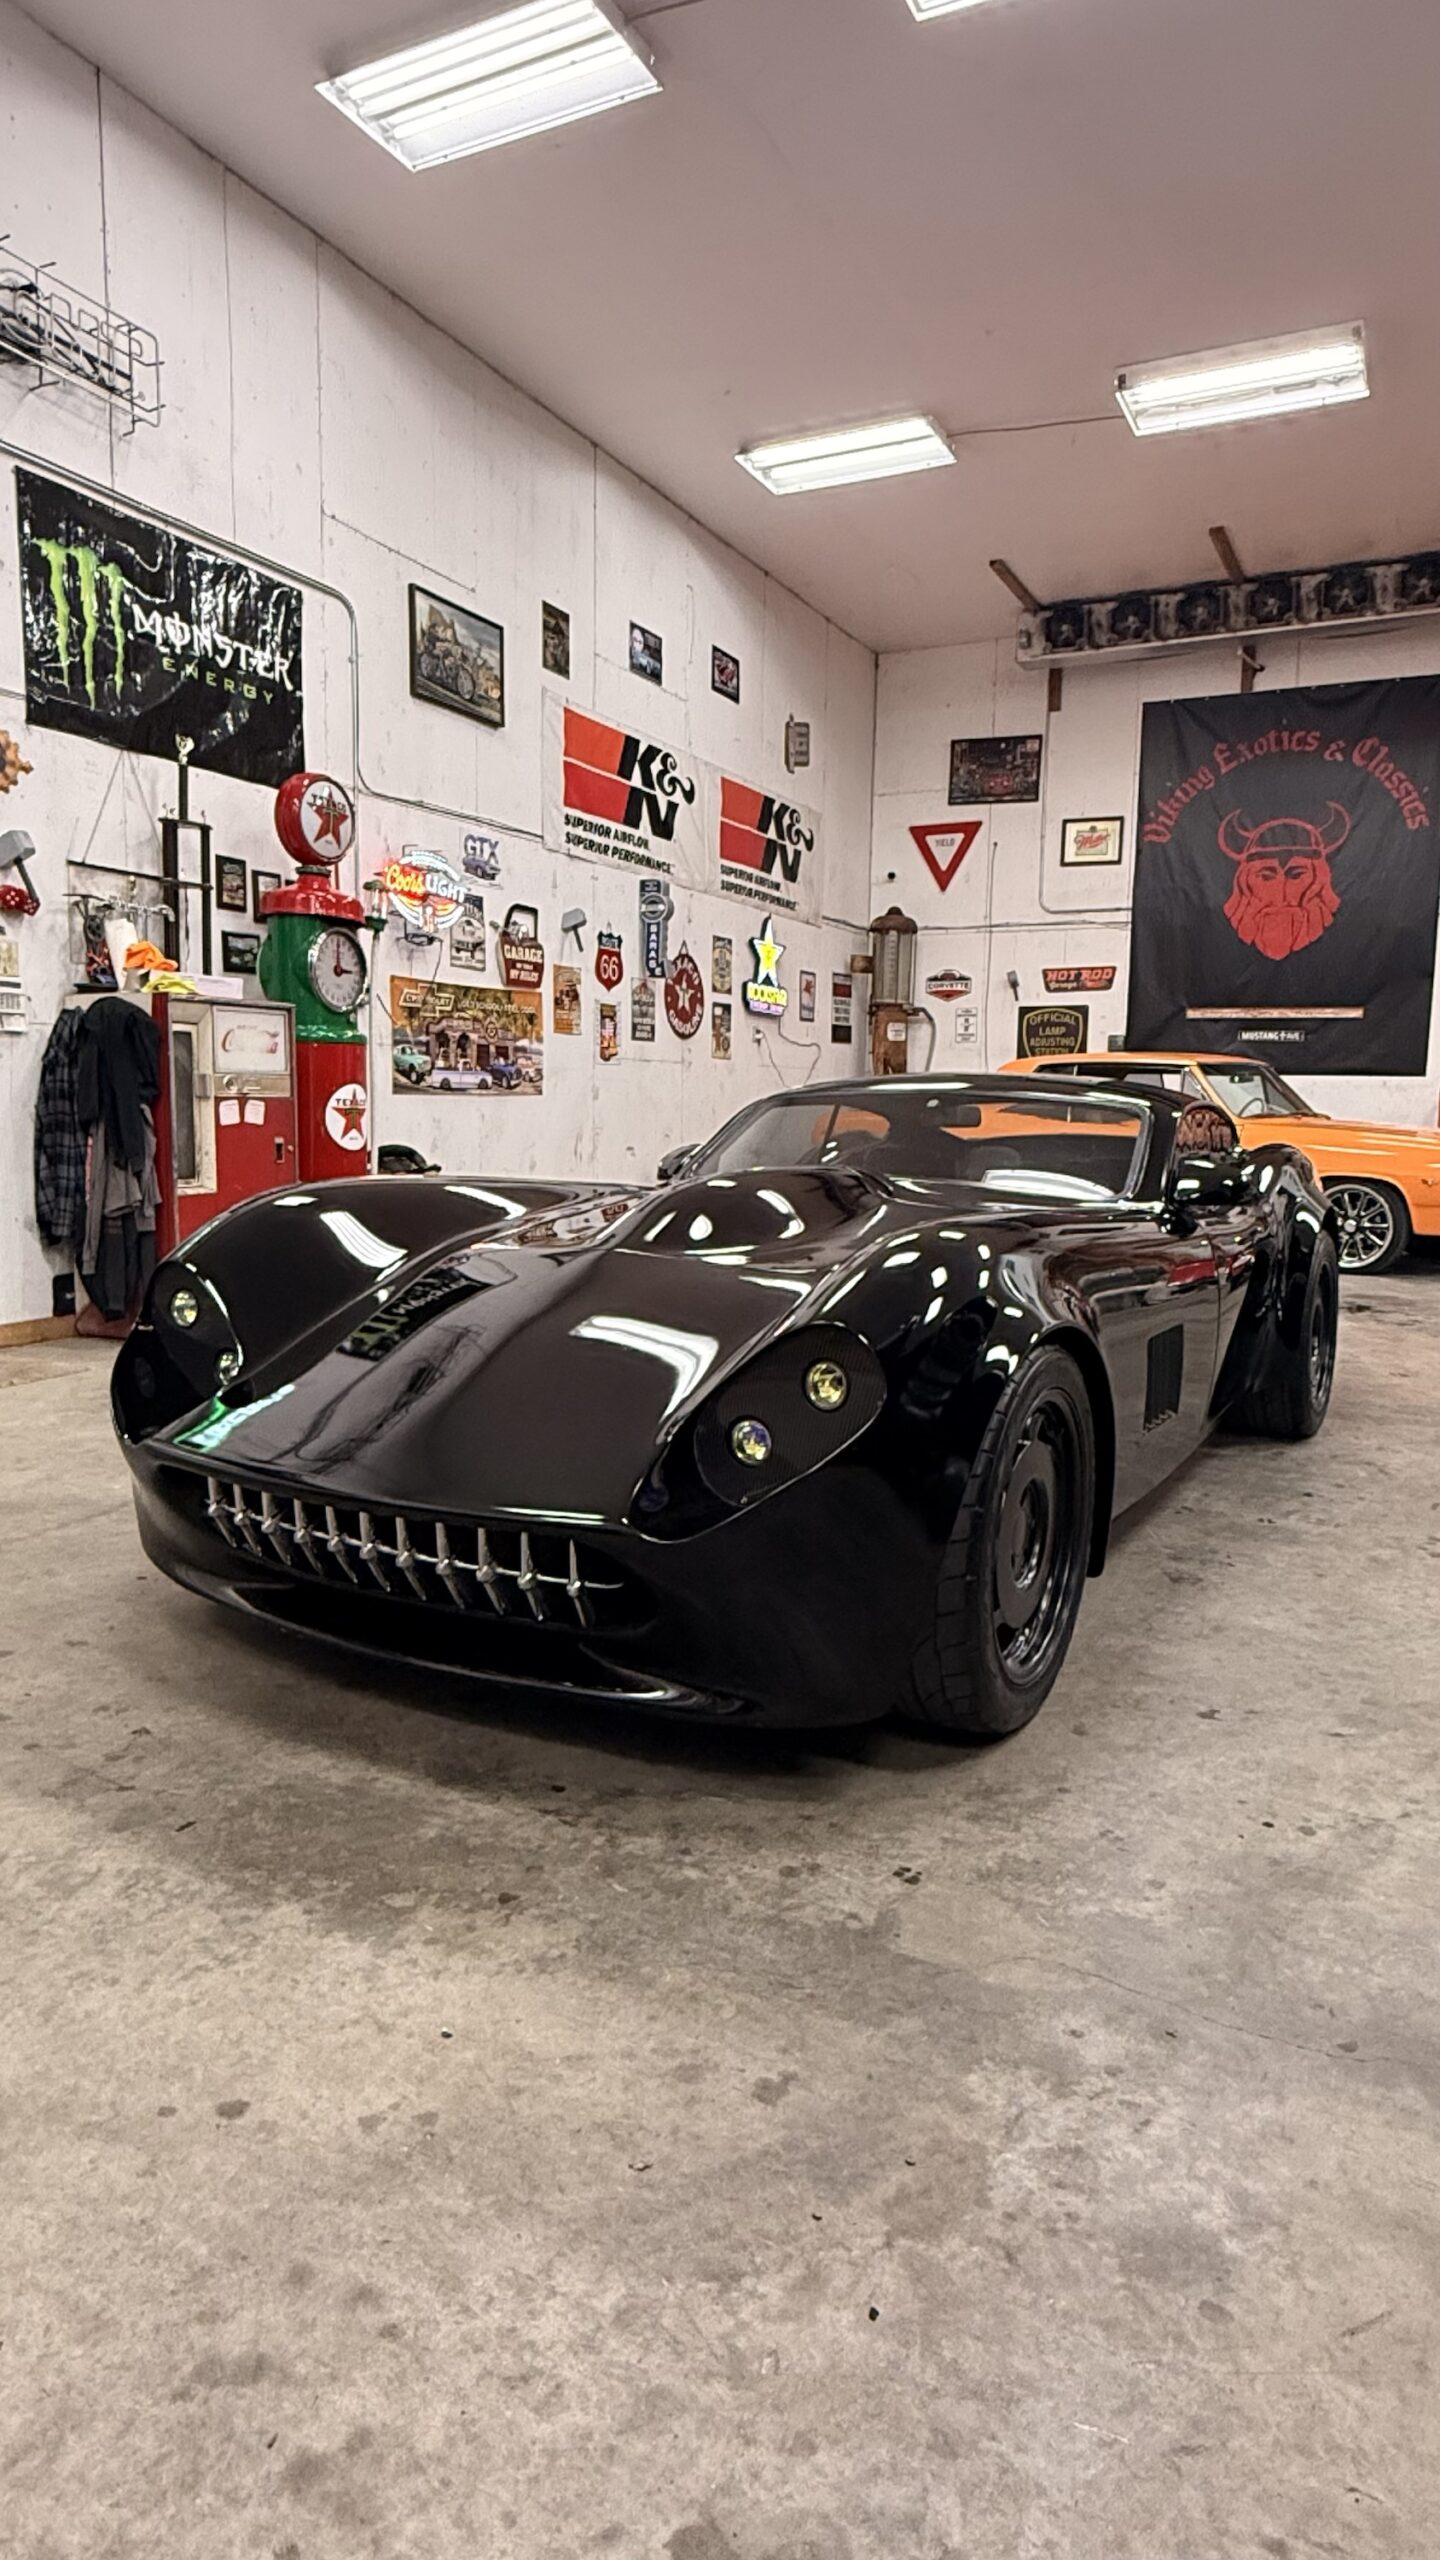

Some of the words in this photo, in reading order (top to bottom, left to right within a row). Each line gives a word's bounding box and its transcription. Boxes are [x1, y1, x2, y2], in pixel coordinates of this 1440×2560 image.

[132, 605, 295, 690] MONSTER
[163, 657, 274, 705] ENERGY
[1143, 766, 1215, 843] Viking
[1212, 729, 1321, 776] Exotics
[1324, 740, 1346, 762] &
[1352, 737, 1430, 830] Classics
[564, 813, 612, 839] SUPERIOR
[463, 834, 499, 865] GTX
[565, 831, 610, 857] SUPERIOR
[934, 838, 955, 847] YIELD
[386, 863, 426, 893] Coors
[425, 873, 468, 902] LIGHT
[720, 864, 753, 883] SUPERIOR
[720, 880, 753, 899] SUPERIOR
[503, 943, 543, 963] GARAGE
[601, 954, 619, 980] 66
[1045, 970, 1078, 981] HOT
[1080, 968, 1113, 980] ROD
[927, 981, 970, 991] CORVETTE
[1029, 1011, 1076, 1026] OFFICIAL
[1039, 1026, 1066, 1036] LAMP
[1241, 1031, 1279, 1040] MUSTANG
[1029, 1037, 1076, 1047] ADJUSTING
[335, 1098, 366, 1106] TEXAC
